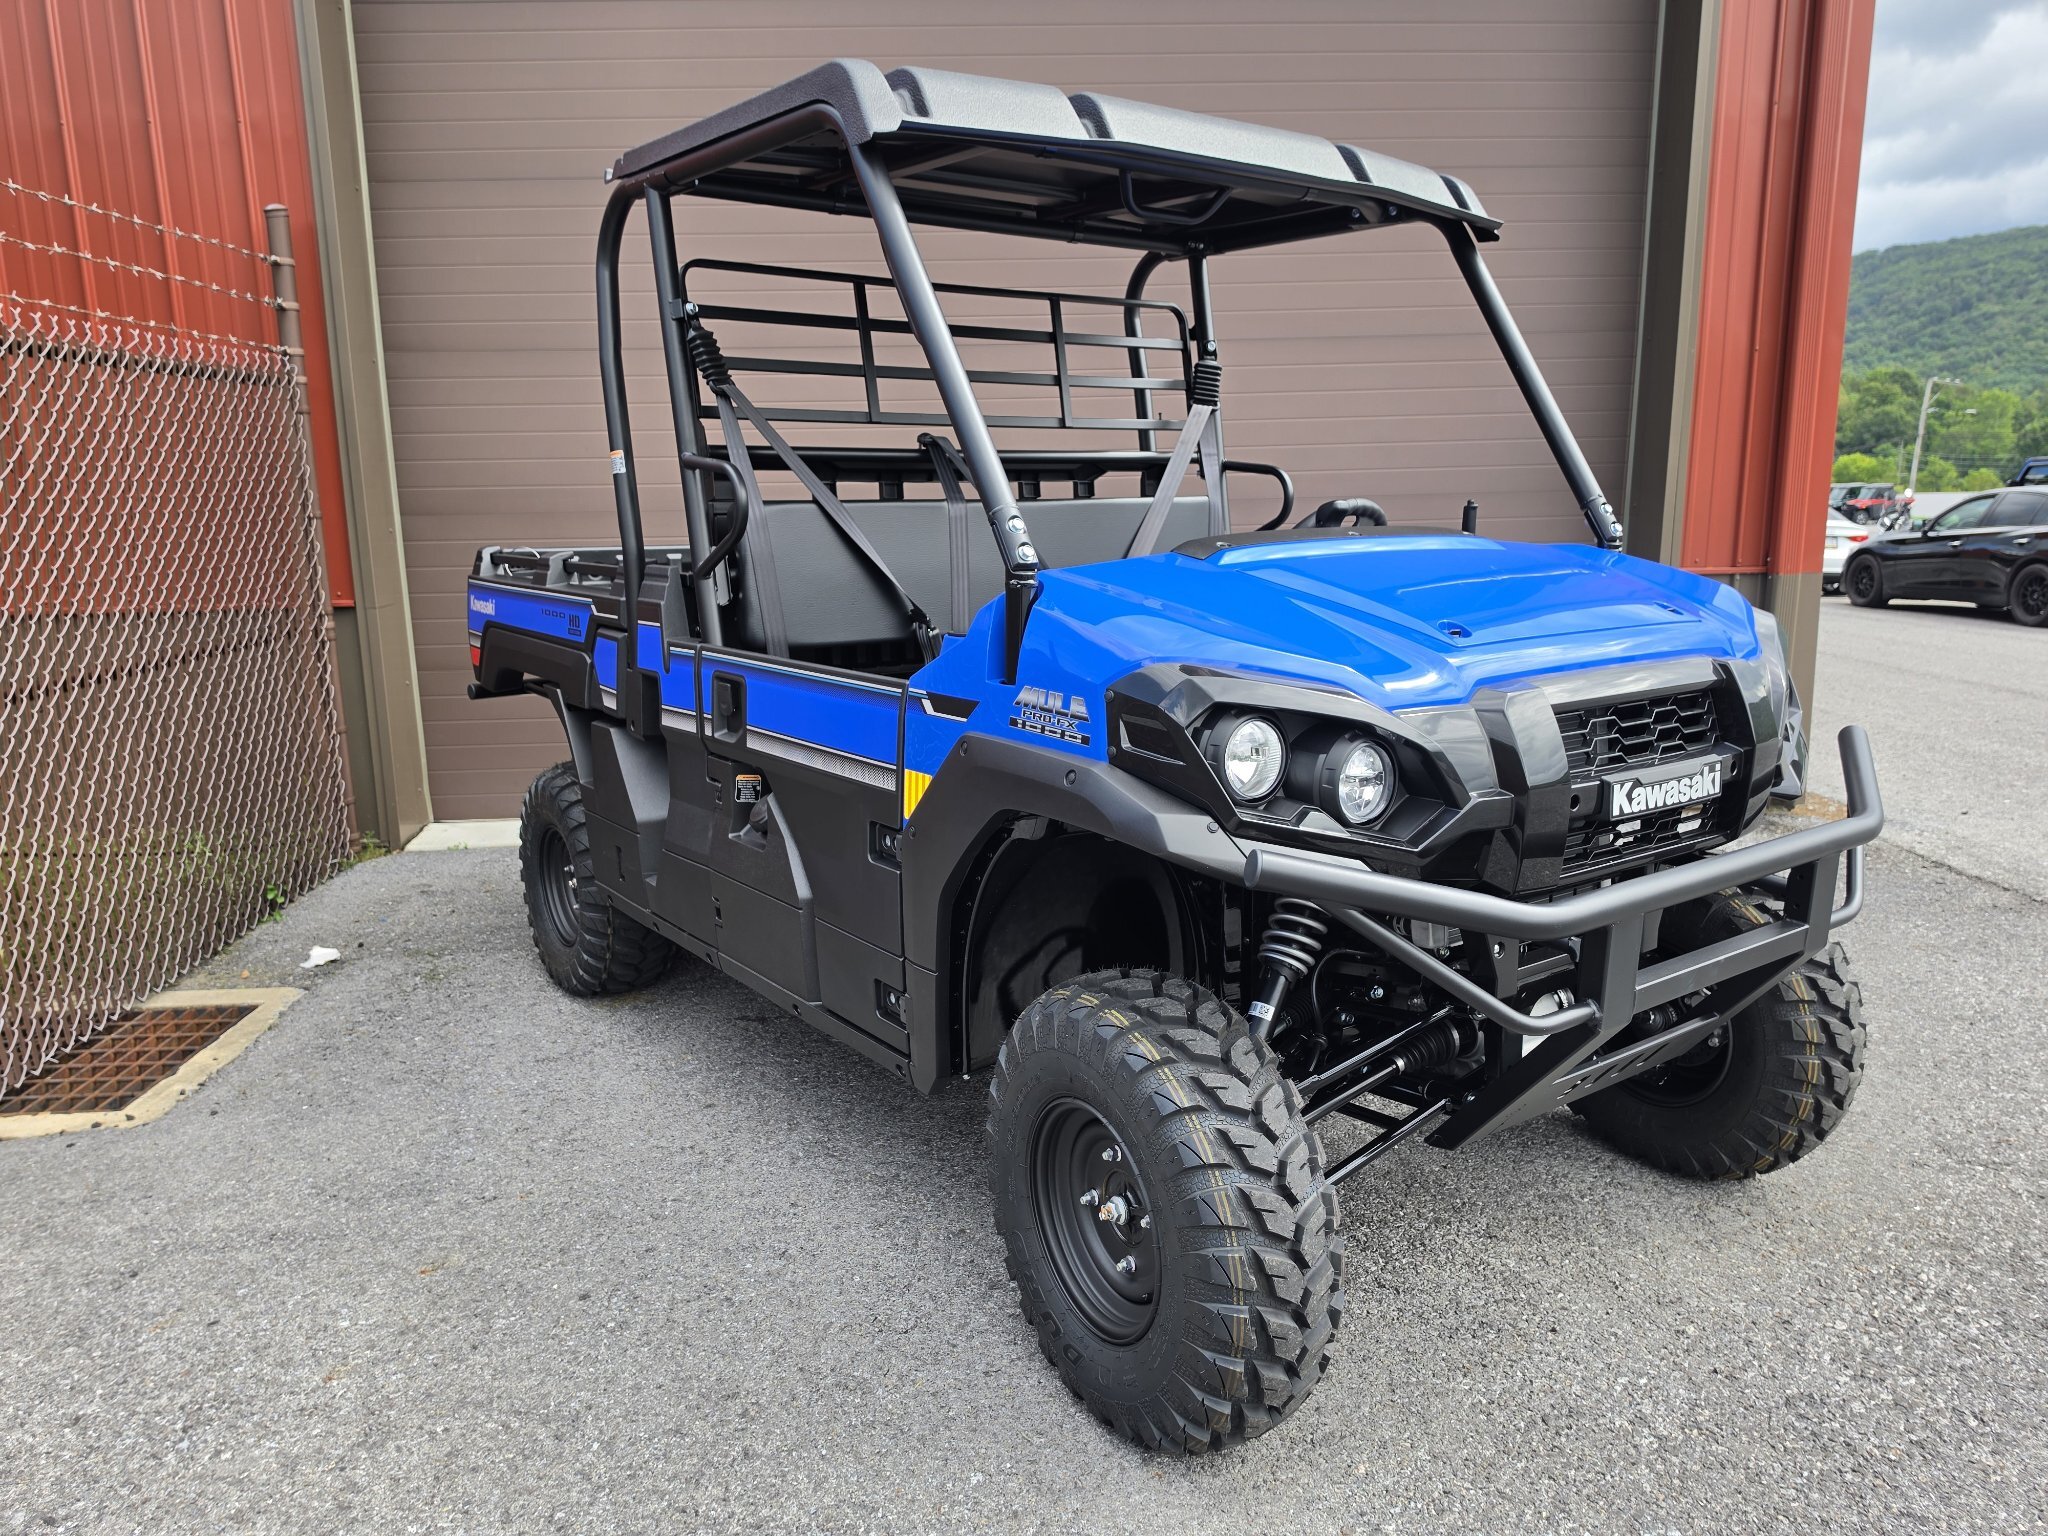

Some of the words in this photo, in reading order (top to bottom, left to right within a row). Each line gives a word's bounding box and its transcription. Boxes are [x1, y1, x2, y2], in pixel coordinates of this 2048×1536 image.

[470, 594, 496, 616] Kawasaki
[541, 608, 566, 619] 1000
[568, 613, 580, 629] HD
[1013, 685, 1091, 723] MULE
[1017, 719, 1081, 744] 1000
[1612, 763, 1721, 817] Kawasaki
